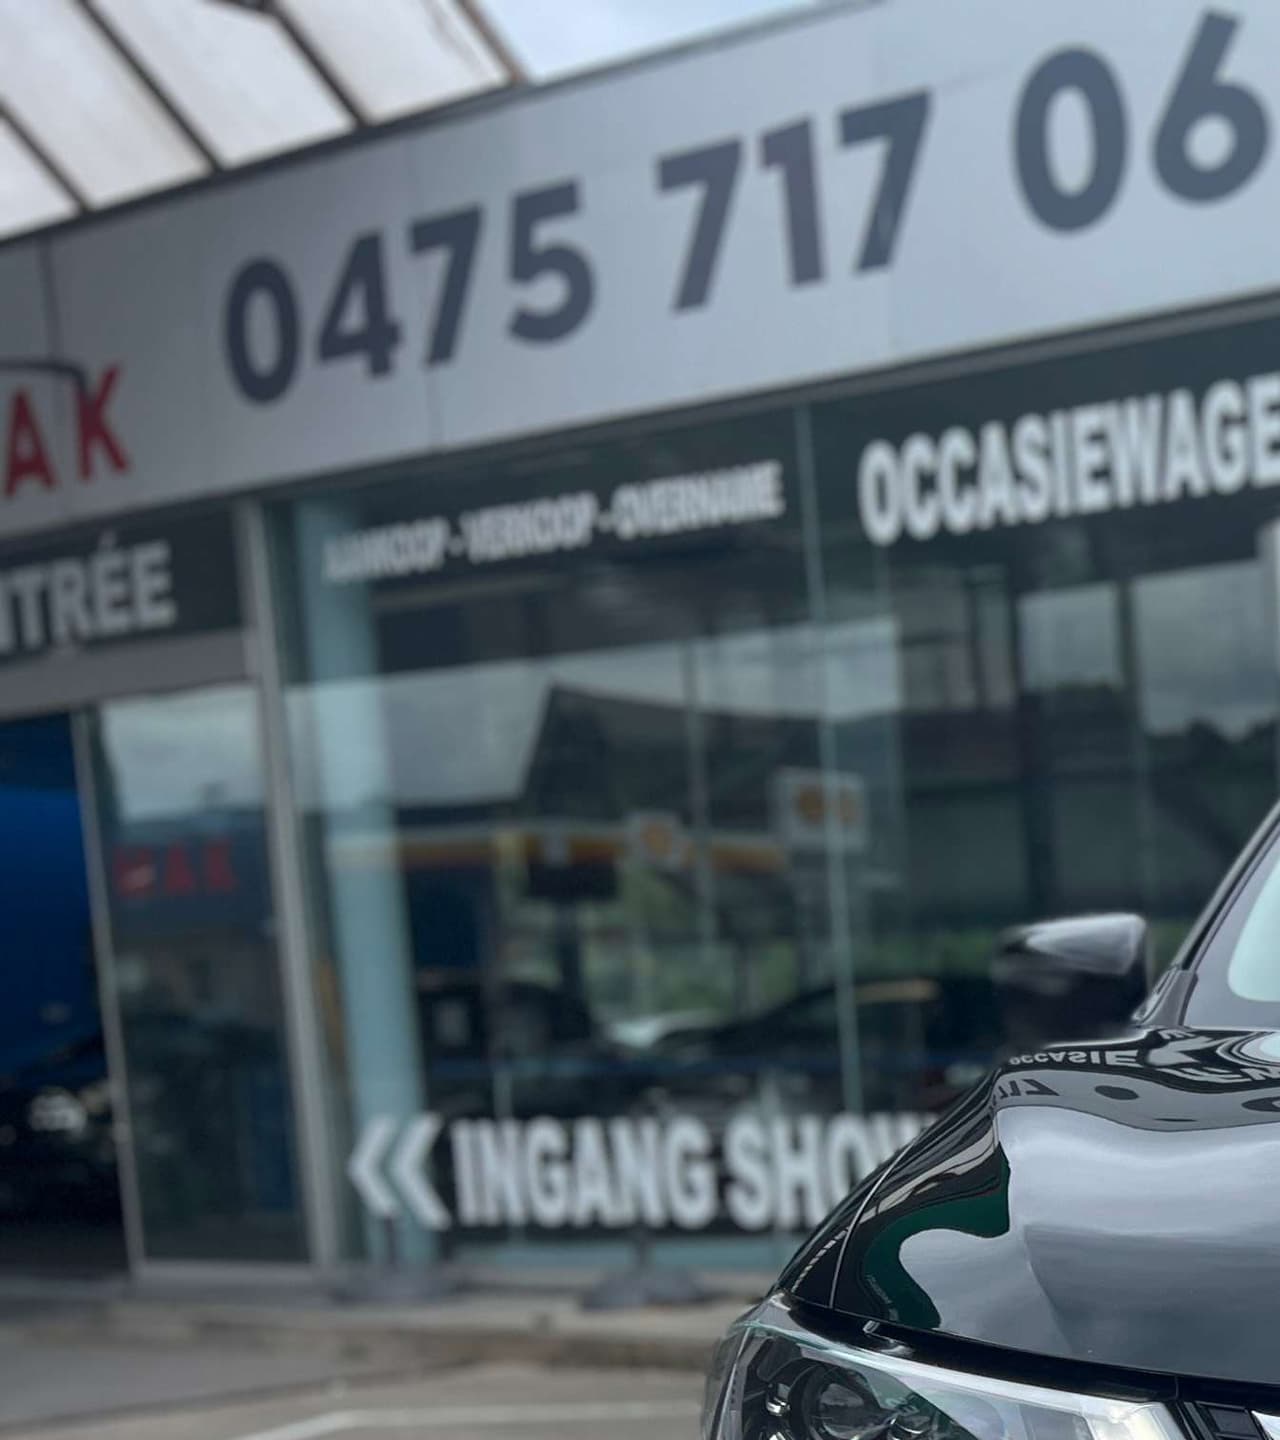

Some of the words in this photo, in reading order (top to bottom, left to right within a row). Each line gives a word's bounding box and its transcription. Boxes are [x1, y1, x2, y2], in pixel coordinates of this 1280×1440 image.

[222, 178, 596, 406] 0475
[654, 88, 933, 316] 717
[450, 1112, 719, 1233] INGANG
